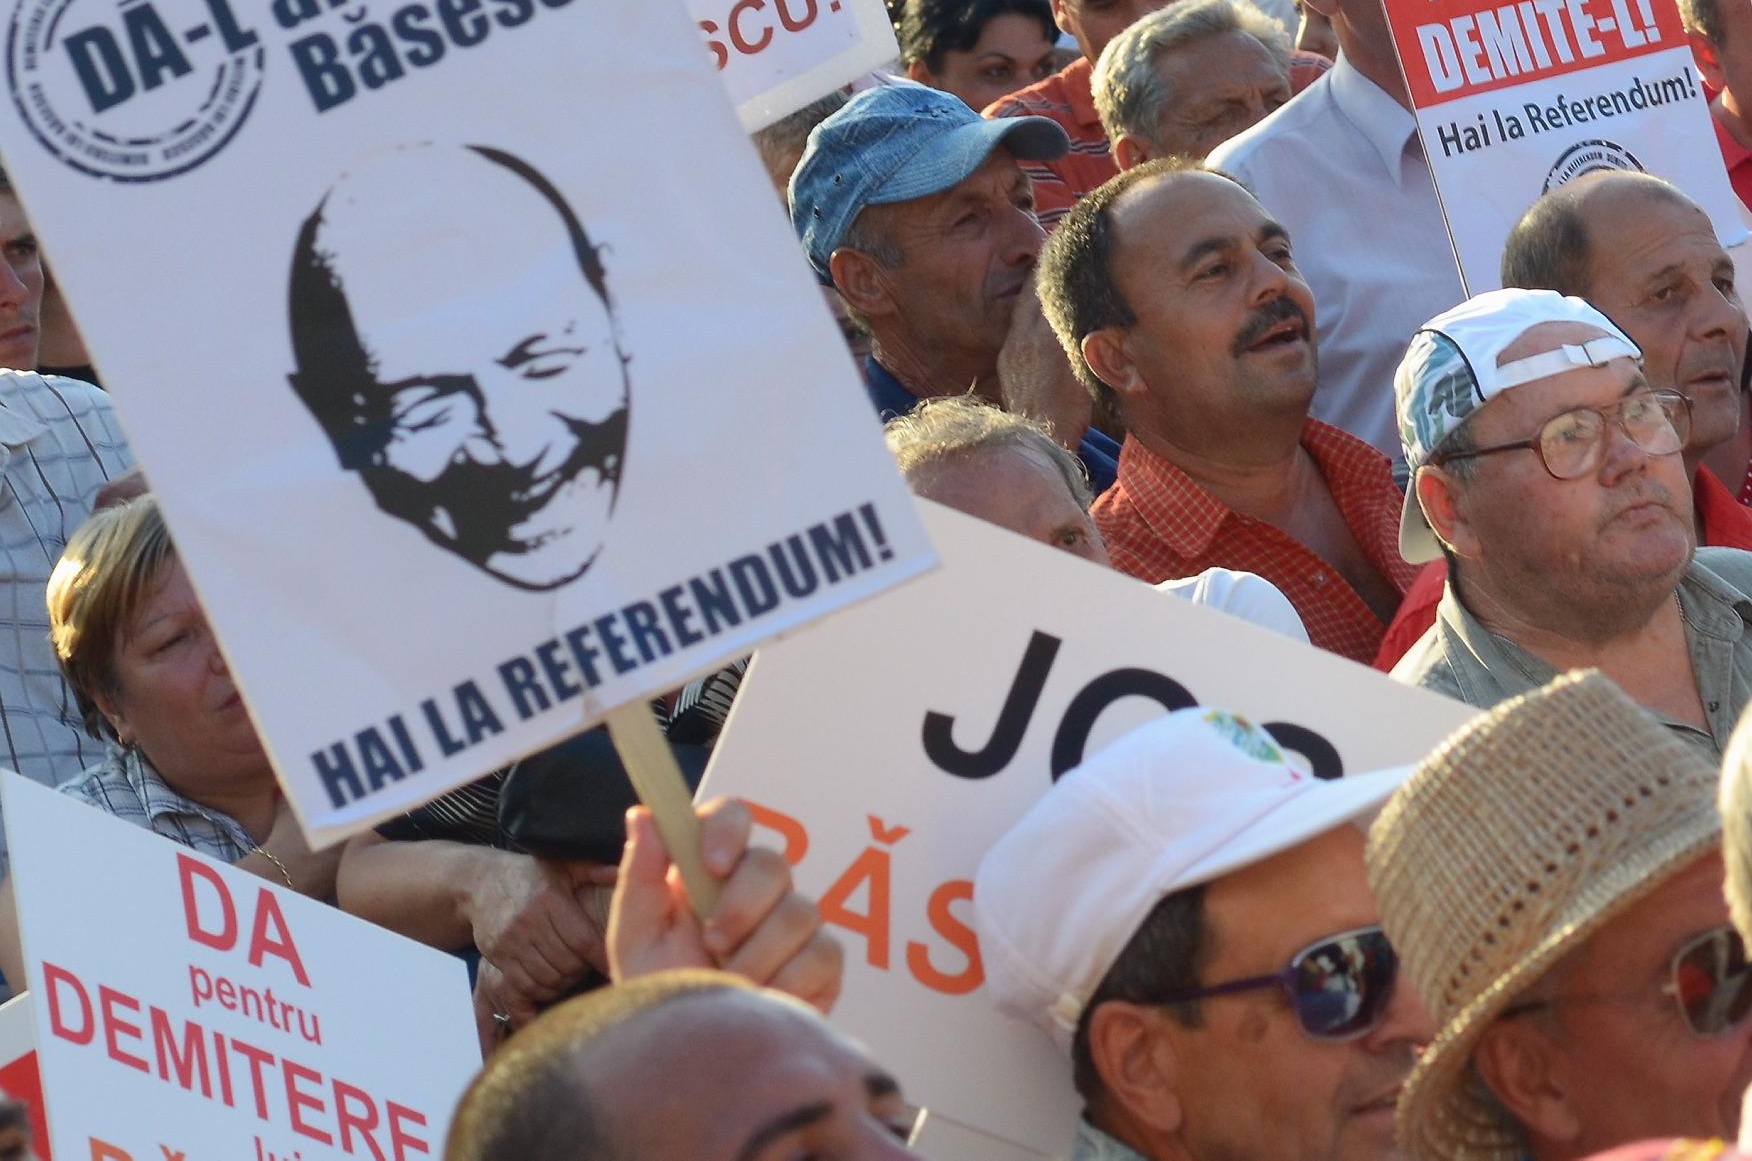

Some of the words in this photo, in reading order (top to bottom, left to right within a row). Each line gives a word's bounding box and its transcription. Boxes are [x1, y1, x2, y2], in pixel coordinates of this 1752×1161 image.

[1436, 114, 1490, 158] Hai
[1492, 108, 1526, 143] la
[1524, 66, 1698, 135] Referendum!
[310, 713, 425, 811] HAI
[420, 678, 505, 760] LA
[497, 502, 896, 722] REFERENDUM!
[922, 628, 1344, 785] JO
[176, 851, 312, 989] DA
[188, 964, 323, 1047] pentru
